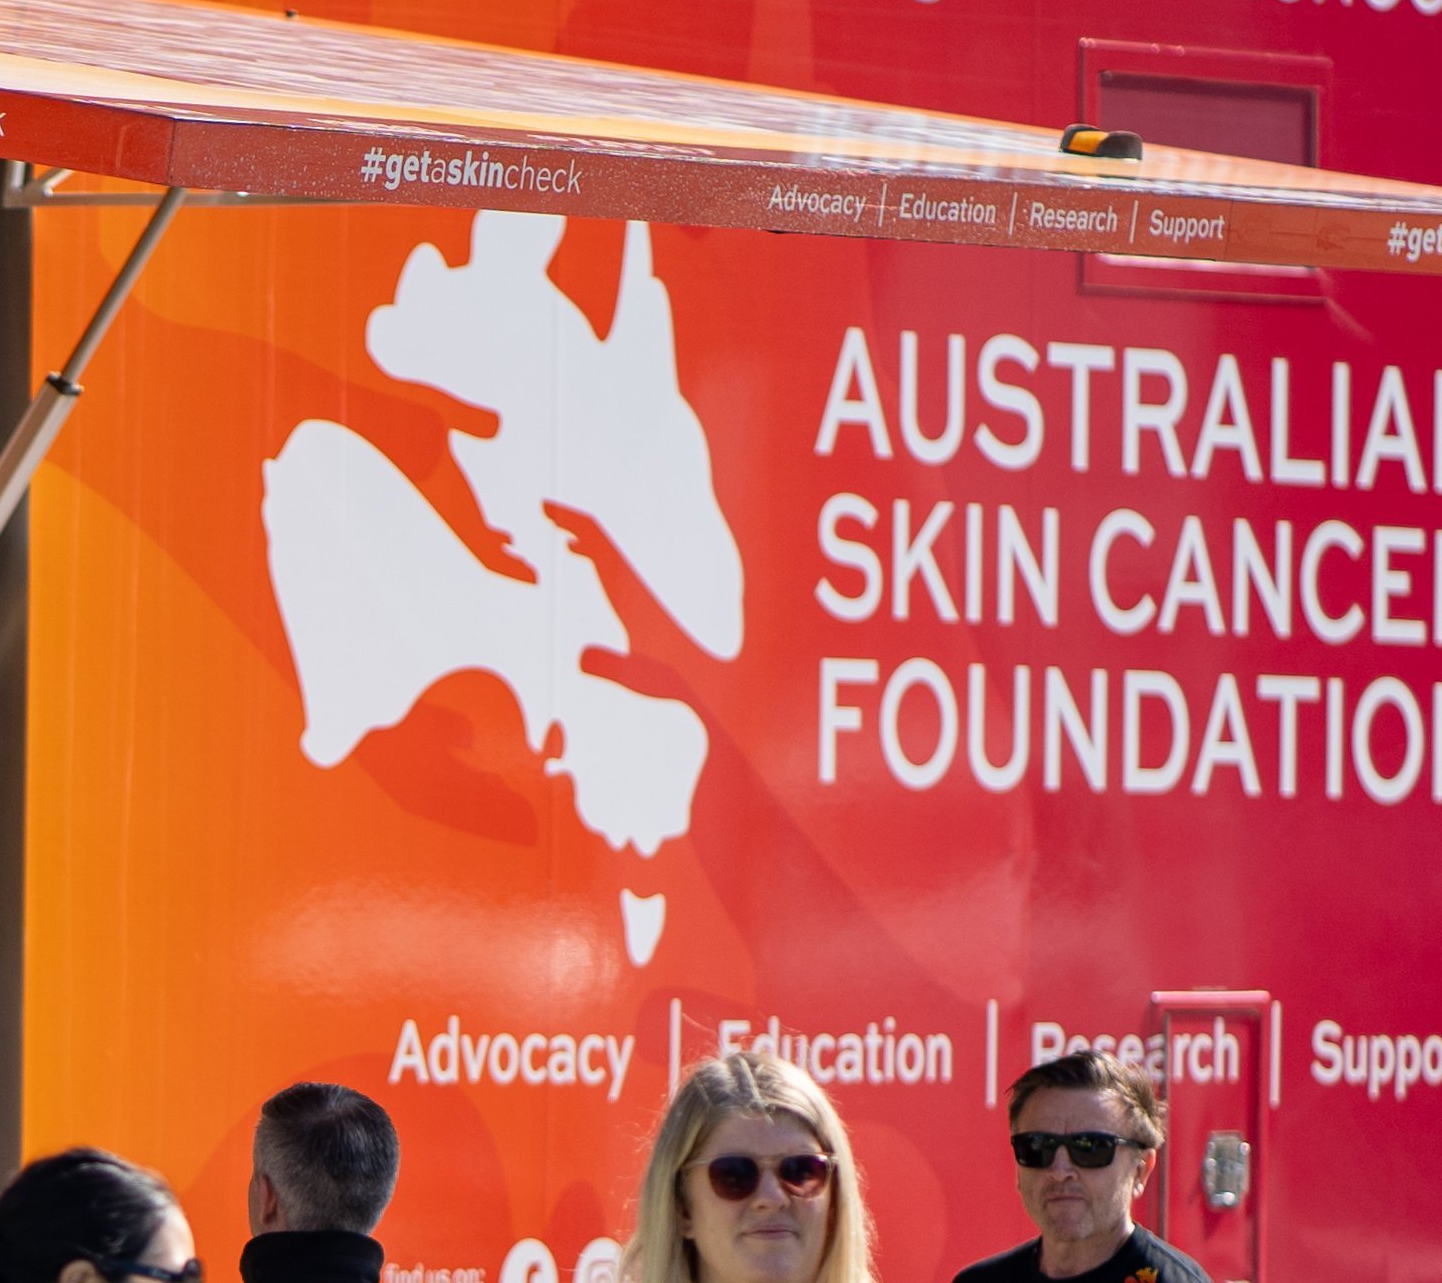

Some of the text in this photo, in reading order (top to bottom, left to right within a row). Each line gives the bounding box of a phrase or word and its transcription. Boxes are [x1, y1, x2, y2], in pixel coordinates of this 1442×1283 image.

[361, 147, 582, 194] #getaskincheck
[768, 184, 867, 217] Advocacy
[898, 192, 996, 224] Education
[1029, 201, 1118, 232] Research
[1149, 209, 1226, 243] Support
[814, 492, 1059, 627] SKIN
[388, 1015, 635, 1102] Advocacy
